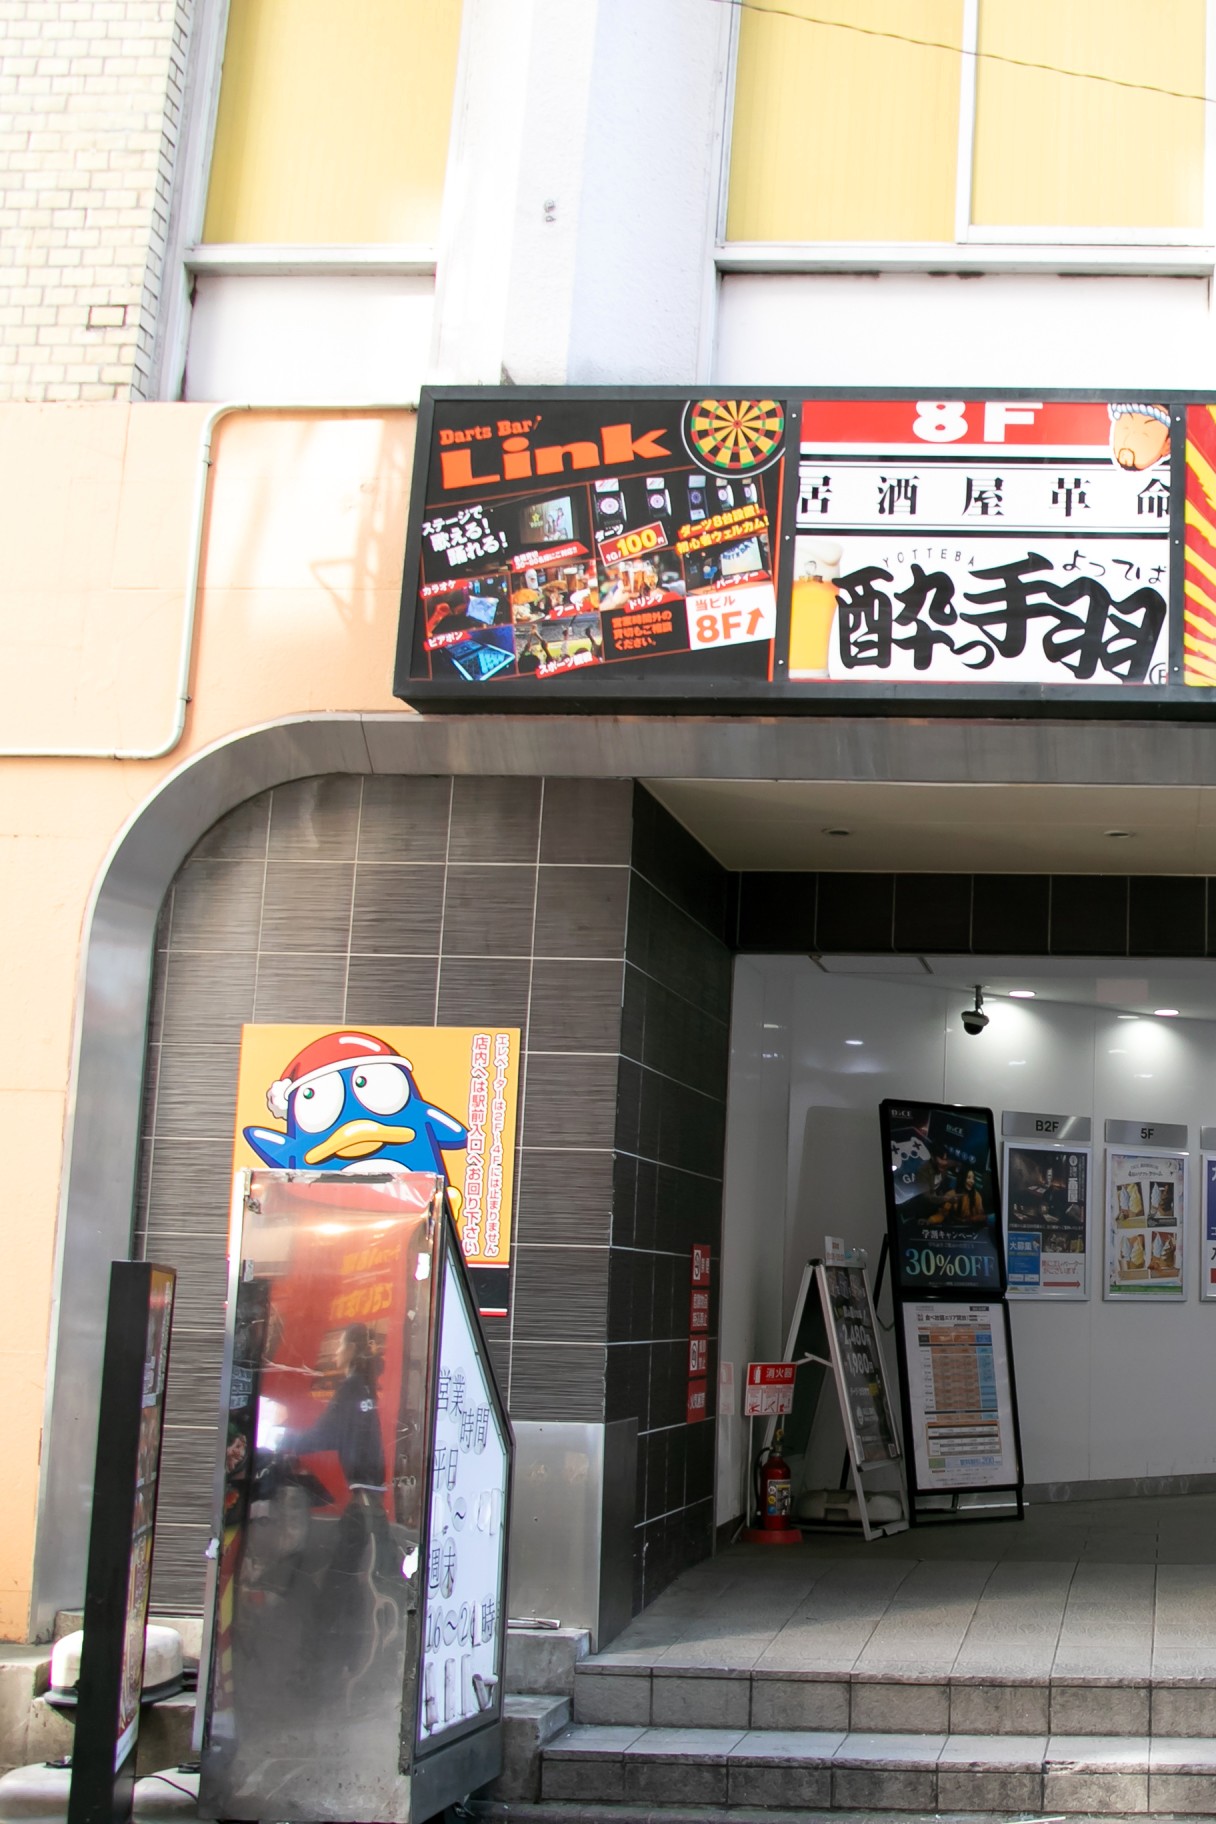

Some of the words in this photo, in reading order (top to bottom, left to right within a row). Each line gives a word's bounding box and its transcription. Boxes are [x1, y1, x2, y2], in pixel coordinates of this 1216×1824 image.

[912, 401, 1043, 442] 8F
[439, 425, 492, 445] Darts
[440, 424, 672, 489] Link
[799, 474, 1170, 518] 居酒屋革命
[422, 505, 483, 536] ステージで
[882, 547, 976, 568] YOTTEBA
[422, 579, 457, 597] カラオケ
[554, 601, 583, 617] フード
[628, 593, 663, 611] ドリンク
[695, 595, 736, 611] 当ビル
[696, 610, 742, 644] 8F
[1035, 1119, 1059, 1132] B2F
[1140, 1127, 1154, 1139] 5F
[464, 1035, 491, 1256] 店内へは駅前入口へお回り下さい
[905, 1248, 995, 1277] 30%OFF
[765, 1367, 793, 1379] 消火器
